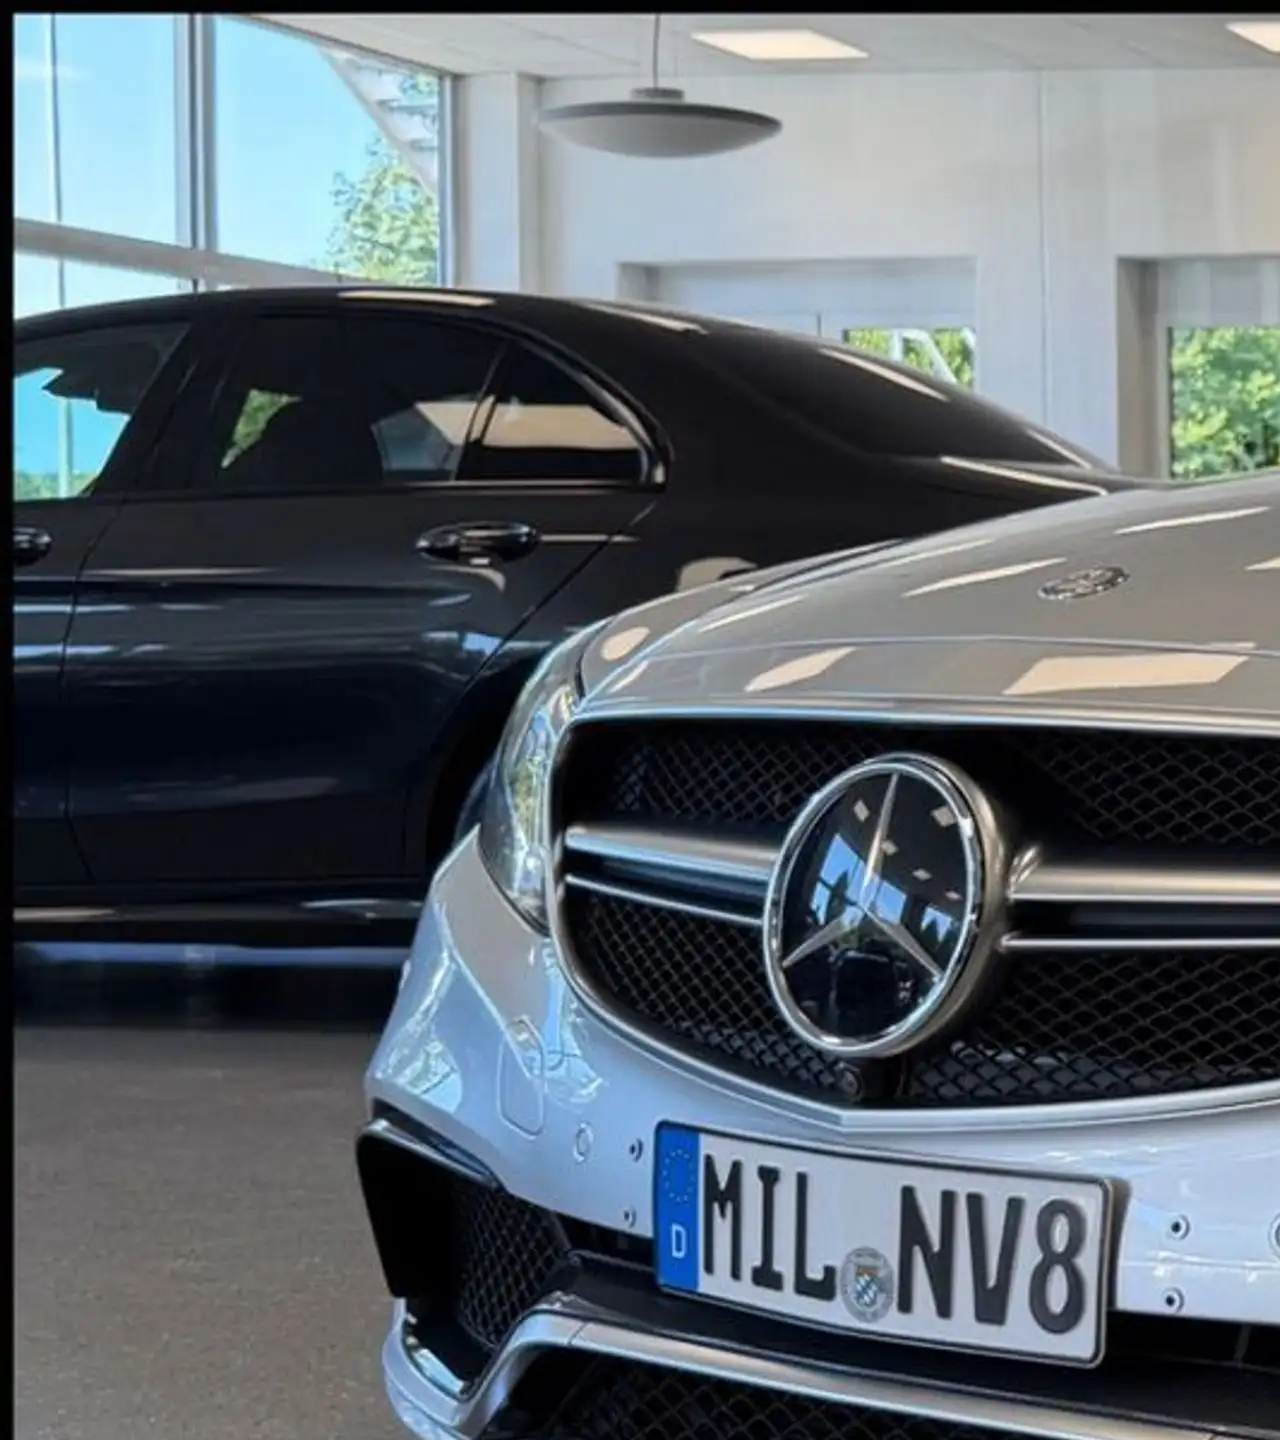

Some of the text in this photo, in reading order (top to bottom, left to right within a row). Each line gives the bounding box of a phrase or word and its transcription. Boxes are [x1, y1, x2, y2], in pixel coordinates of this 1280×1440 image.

[670, 1222, 688, 1259] D
[703, 1152, 836, 1301] MIL
[897, 1185, 1087, 1335] NV8
